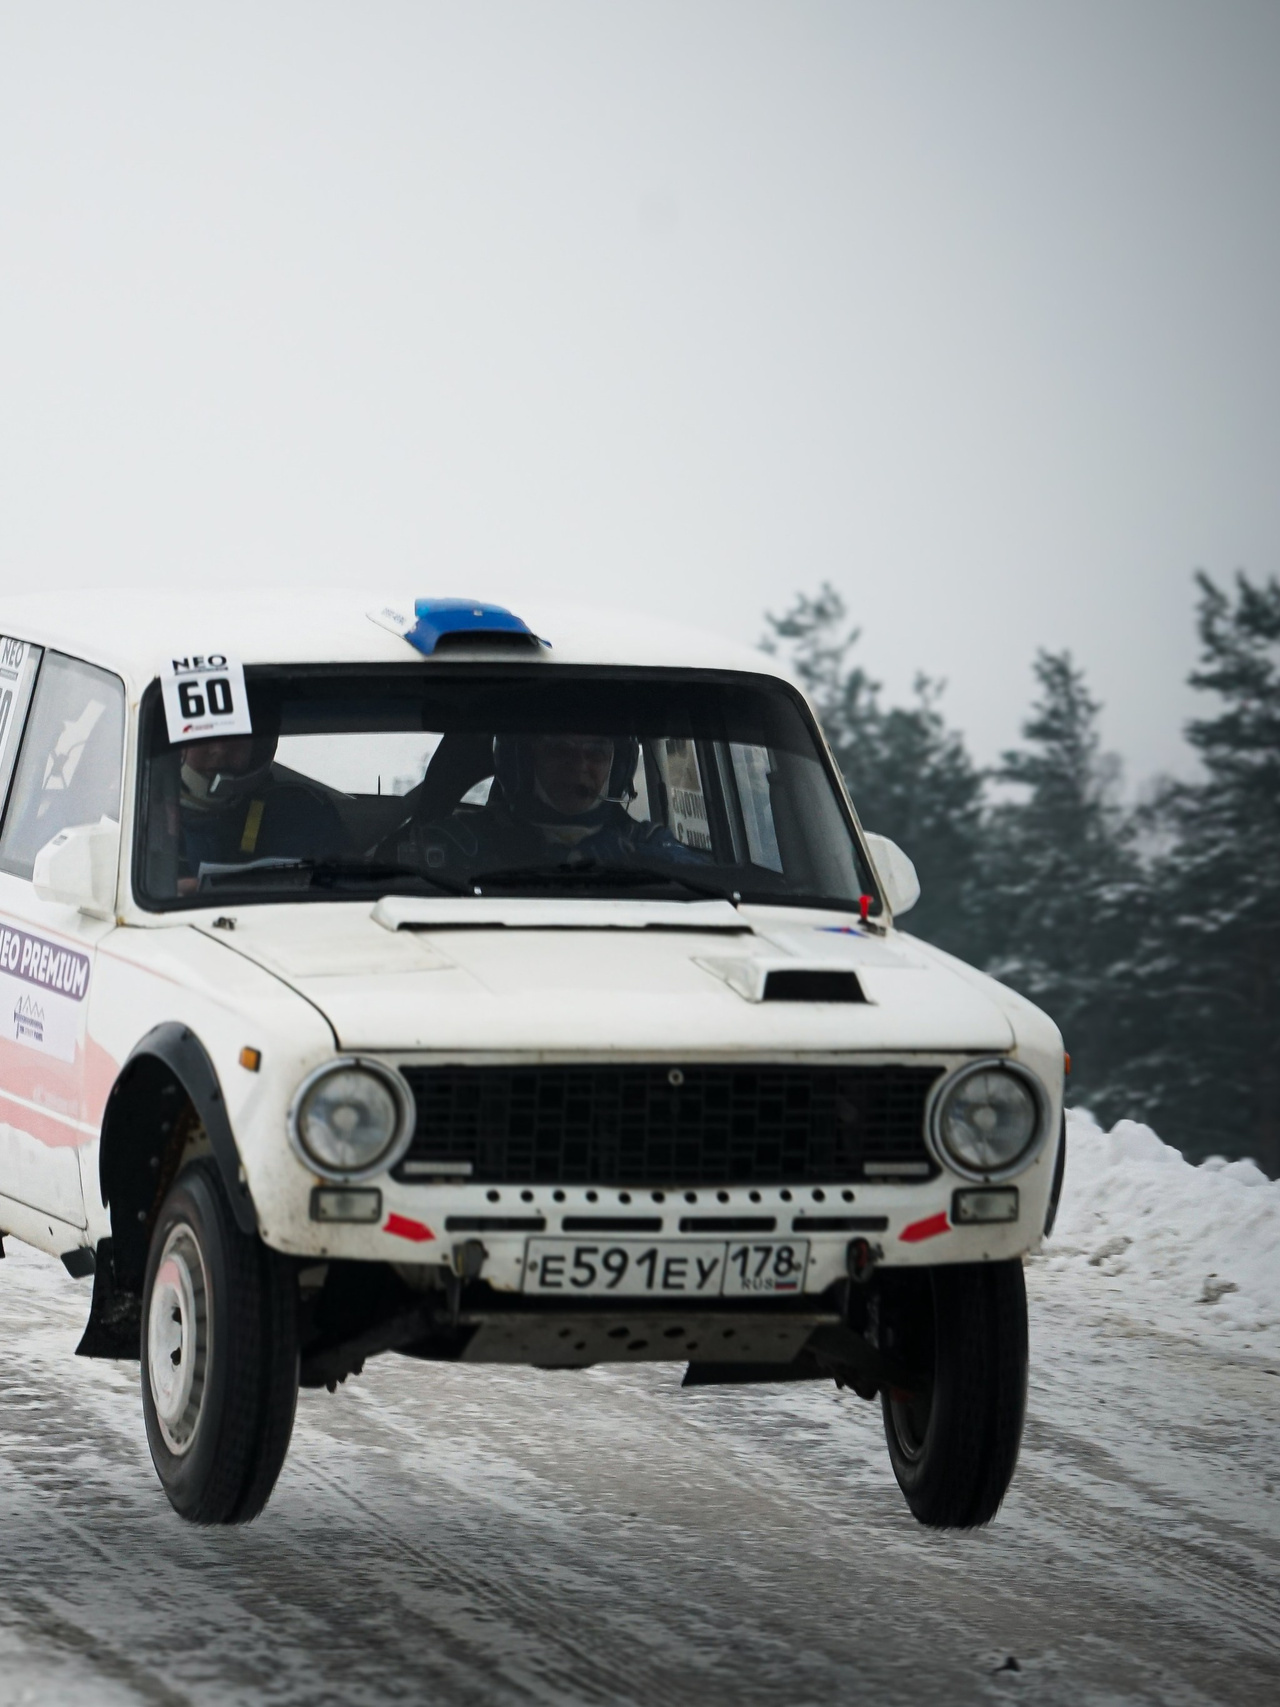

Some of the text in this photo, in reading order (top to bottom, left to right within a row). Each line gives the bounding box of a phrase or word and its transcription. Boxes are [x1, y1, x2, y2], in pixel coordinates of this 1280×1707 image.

[1, 639, 25, 669] NEO
[172, 654, 228, 671] NEO
[178, 678, 234, 720] 60
[20, 940, 89, 997] PREMIUM
[730, 1245, 796, 1278] 178
[740, 1277, 774, 1291] RUS
